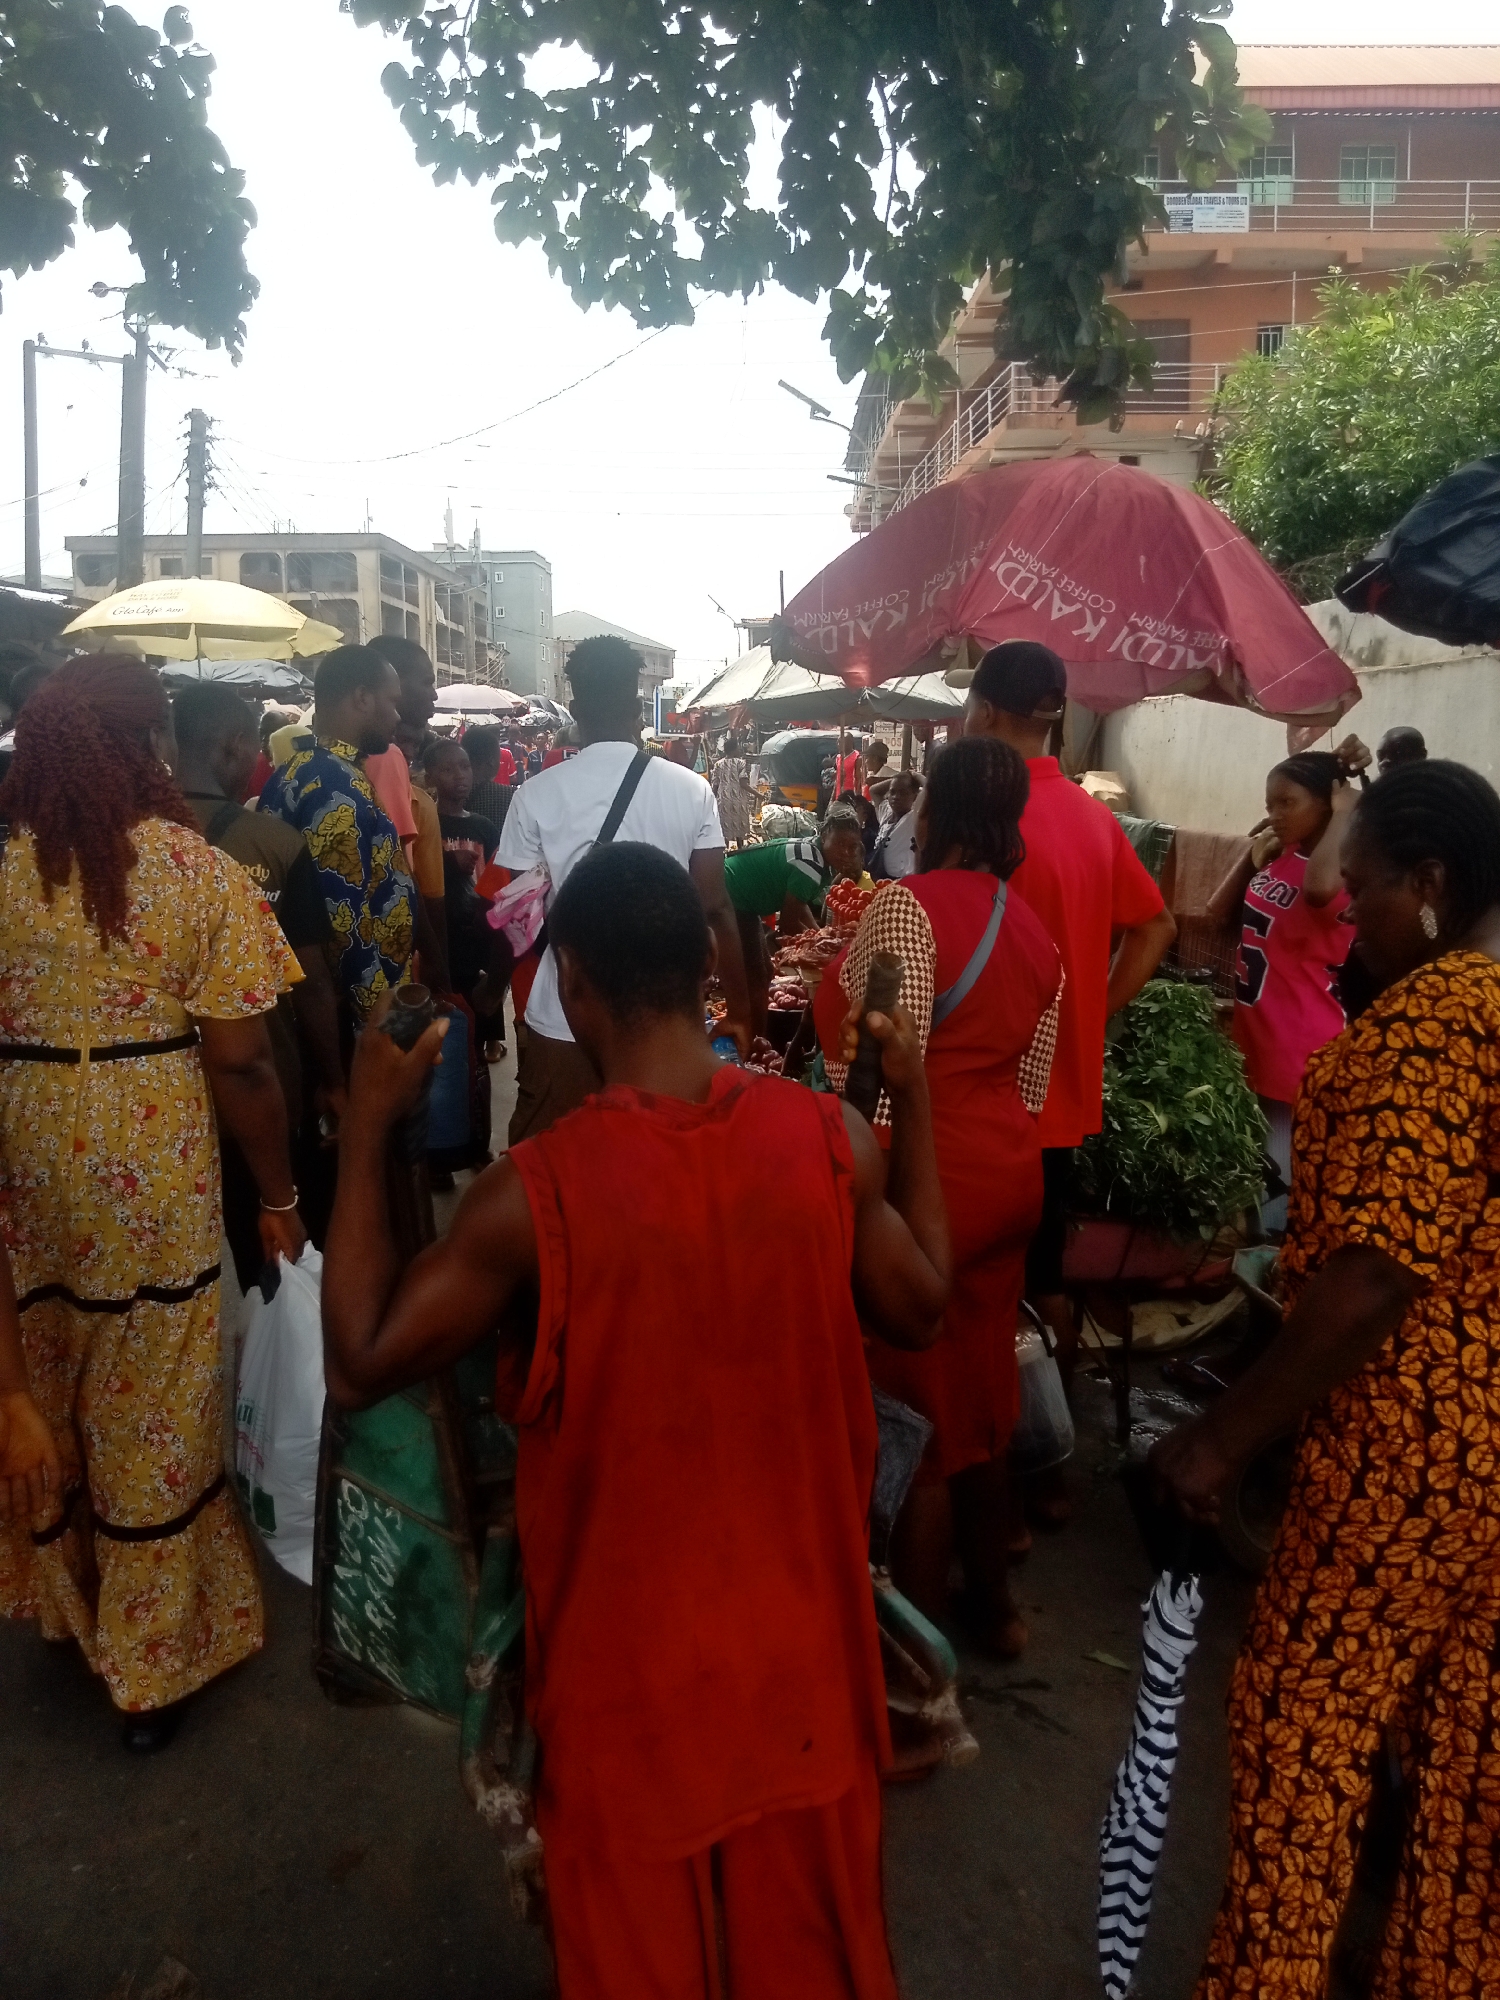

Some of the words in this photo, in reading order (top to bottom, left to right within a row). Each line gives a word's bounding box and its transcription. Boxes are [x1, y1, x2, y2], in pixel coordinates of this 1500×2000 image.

[1203, 196, 1222, 206] TRAVELS
[1225, 196, 1240, 206] TOURS
[855, 589, 910, 618] COFFEE
[1056, 573, 1116, 614] COFFEE
[241, 863, 271, 882] ody
